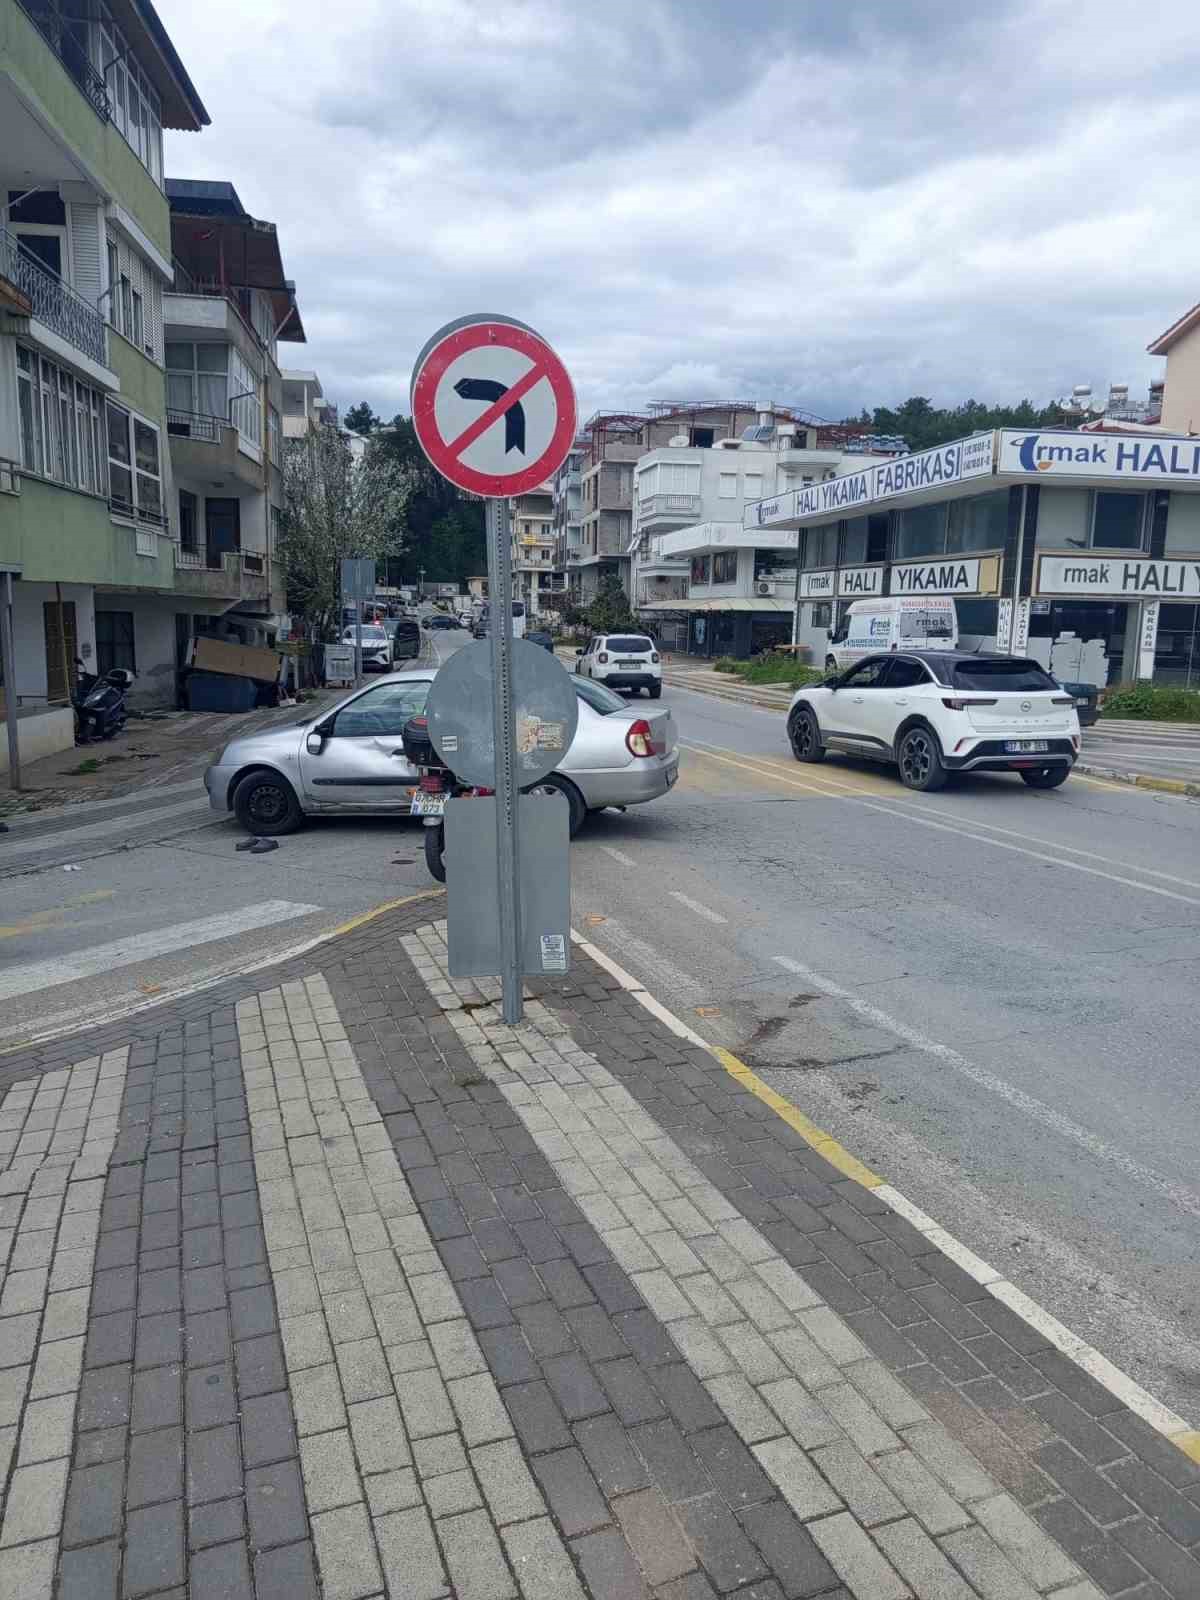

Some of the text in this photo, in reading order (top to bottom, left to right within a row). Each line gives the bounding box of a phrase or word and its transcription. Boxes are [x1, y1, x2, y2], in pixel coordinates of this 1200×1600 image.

[1115, 442, 1200, 475] HALI
[796, 489, 819, 515] HALI
[822, 474, 868, 508] YIKAMA
[844, 571, 876, 592] HALI
[897, 565, 969, 590] YIKAMA
[1121, 563, 1185, 592] HALI
